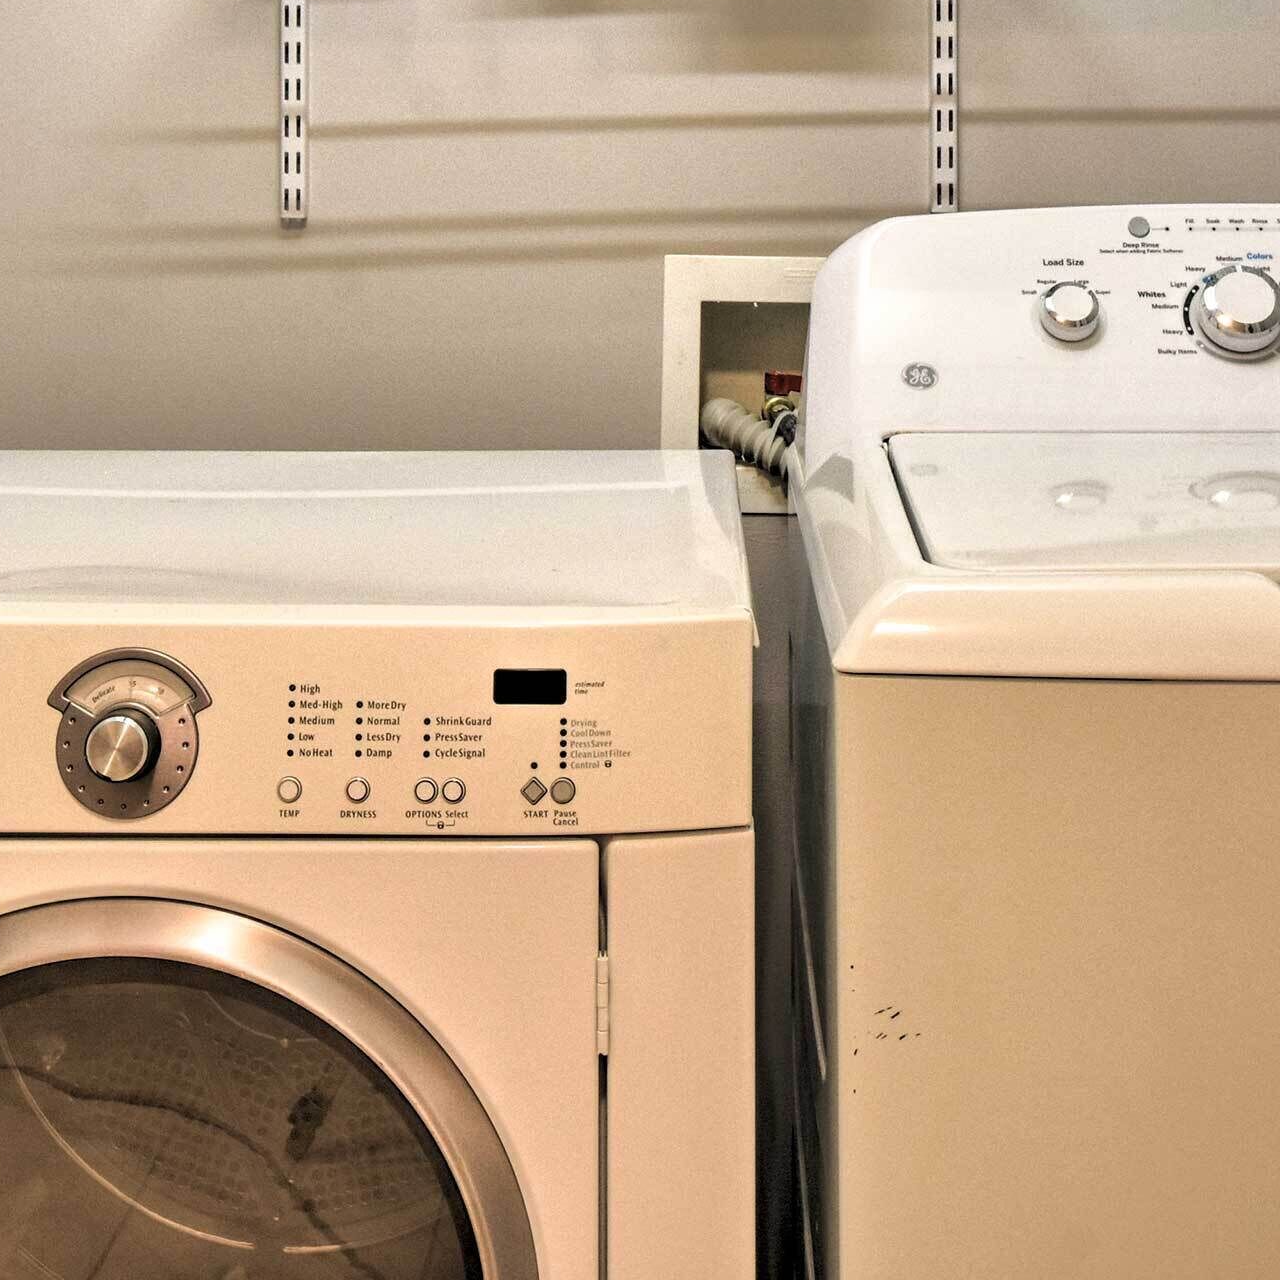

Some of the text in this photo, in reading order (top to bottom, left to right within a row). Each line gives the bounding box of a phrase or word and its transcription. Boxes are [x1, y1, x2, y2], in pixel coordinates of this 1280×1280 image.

[300, 684, 320, 696] High
[300, 700, 343, 712] Med-High
[298, 716, 335, 726] Medium
[367, 717, 400, 726] Normal
[570, 720, 598, 728] Drying
[298, 733, 314, 741] Low
[366, 749, 392, 758] Damp
[278, 810, 300, 818] TEMP
[340, 810, 377, 818] DRYNESS
[405, 810, 468, 818] OPTIONS Select
[552, 818, 578, 826] Cancel
